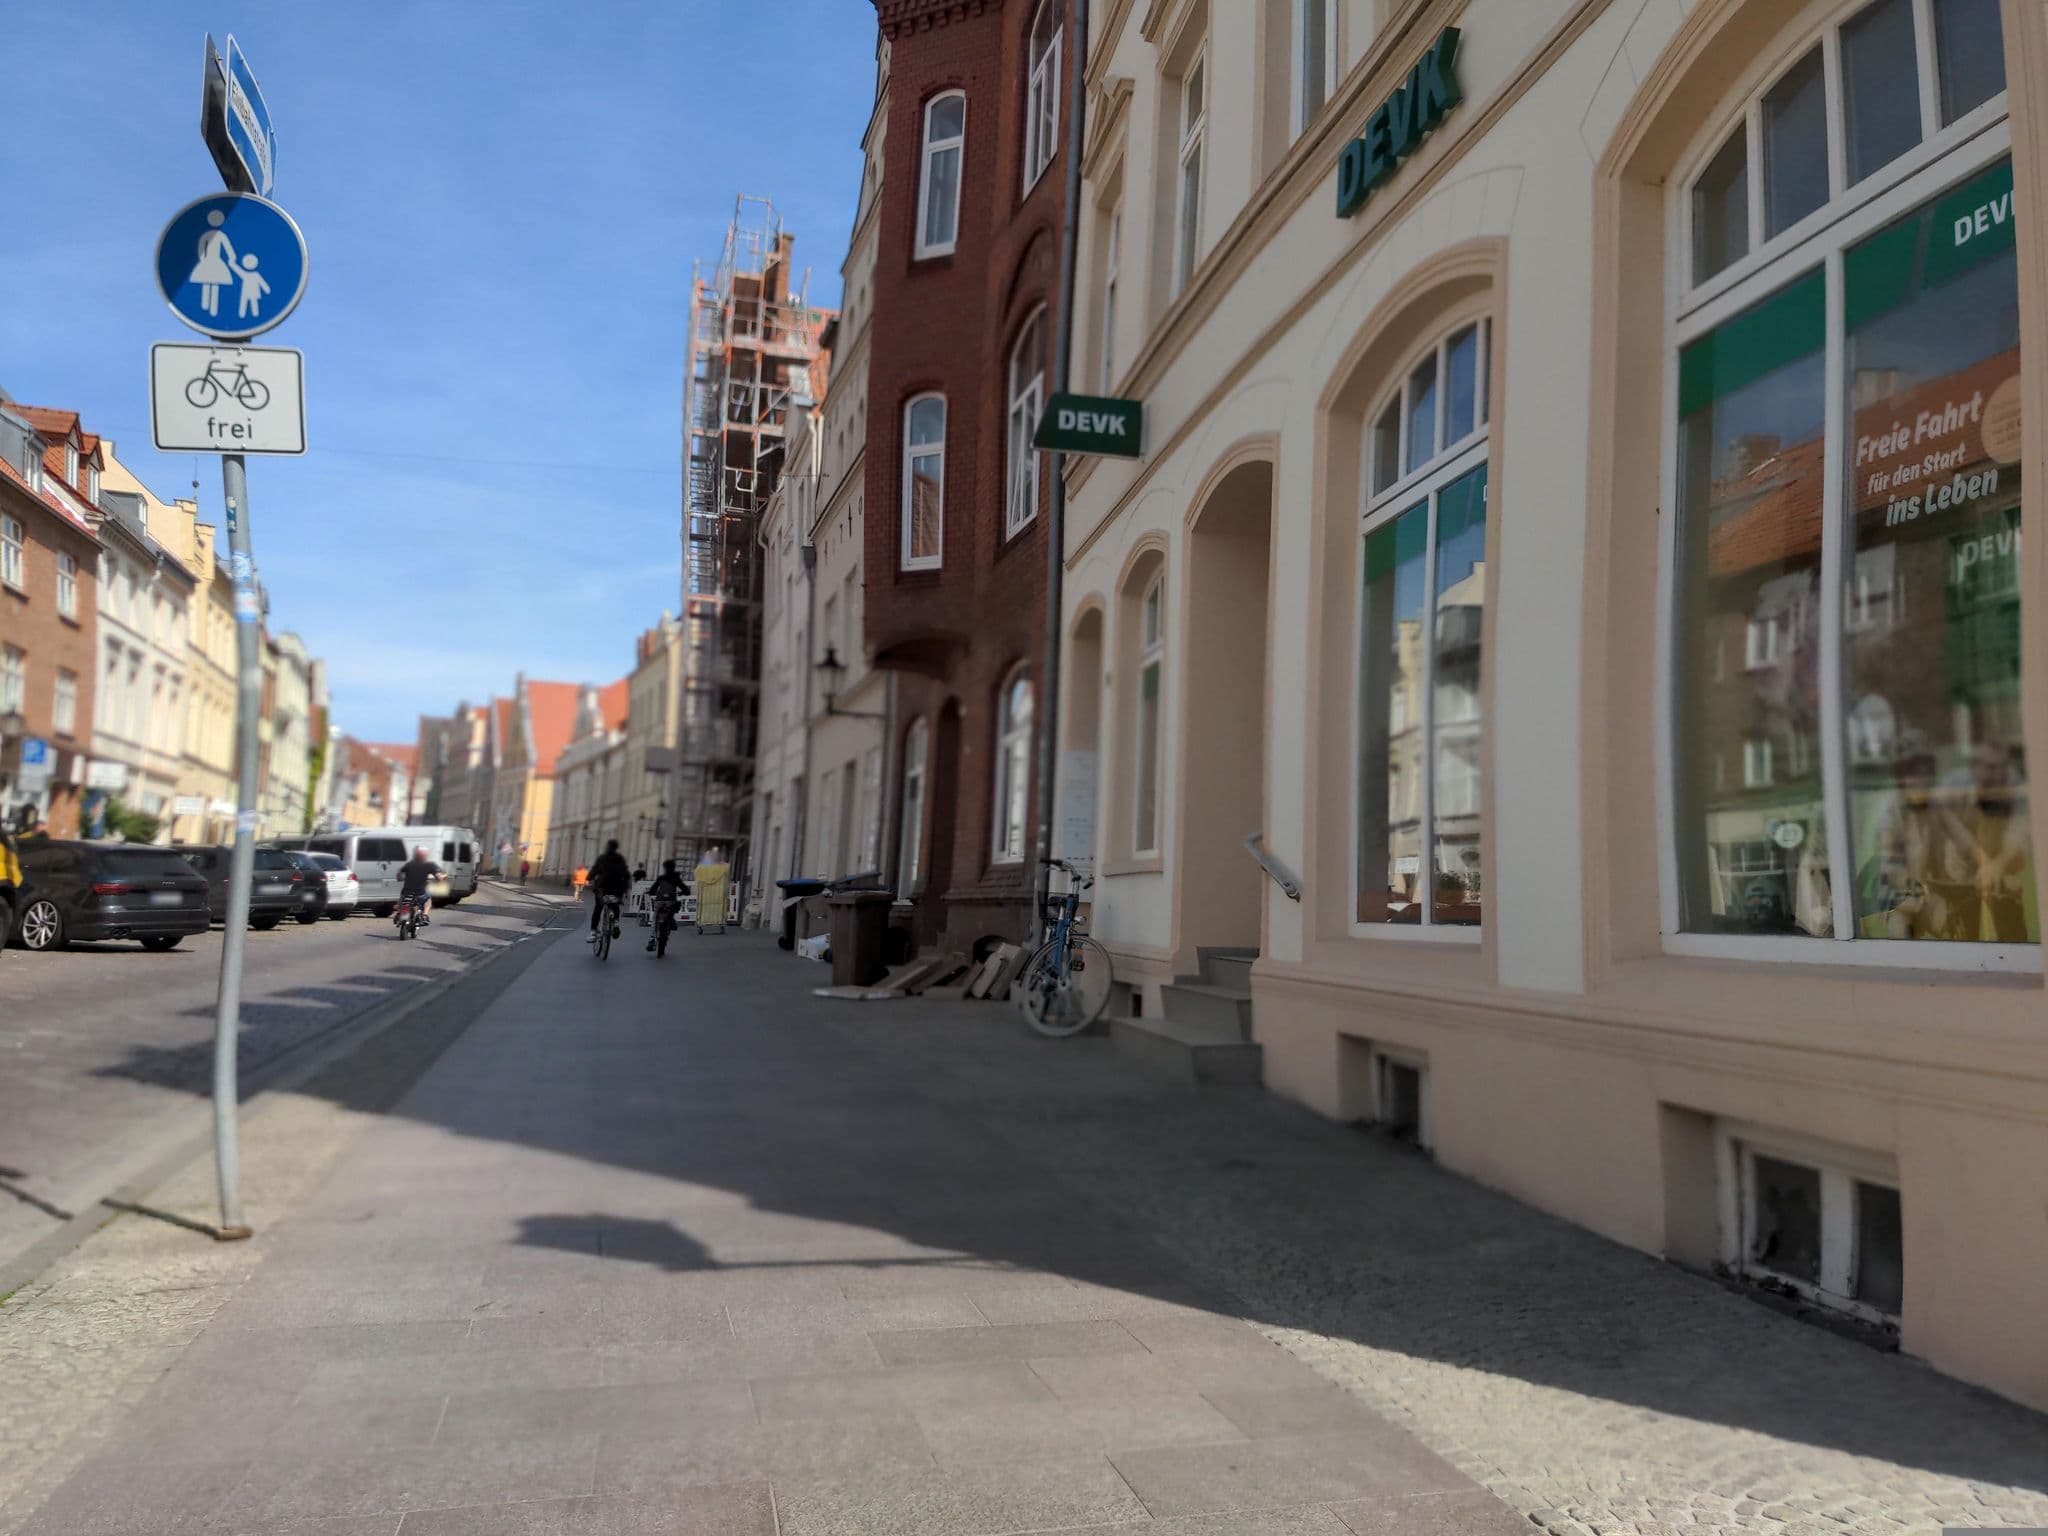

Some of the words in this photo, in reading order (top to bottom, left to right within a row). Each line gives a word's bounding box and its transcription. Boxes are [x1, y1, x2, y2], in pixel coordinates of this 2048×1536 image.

[1336, 26, 1463, 219] DEVK
[207, 416, 252, 439] frei
[1058, 408, 1126, 437] DEVK
[1856, 421, 1911, 467] Freie
[1914, 390, 1983, 445] Fahrt
[1867, 471, 1890, 496] für
[1892, 462, 1920, 486] den
[1923, 441, 1967, 475] Start
[1885, 493, 1920, 527] ins
[1925, 467, 1999, 515] Leben
